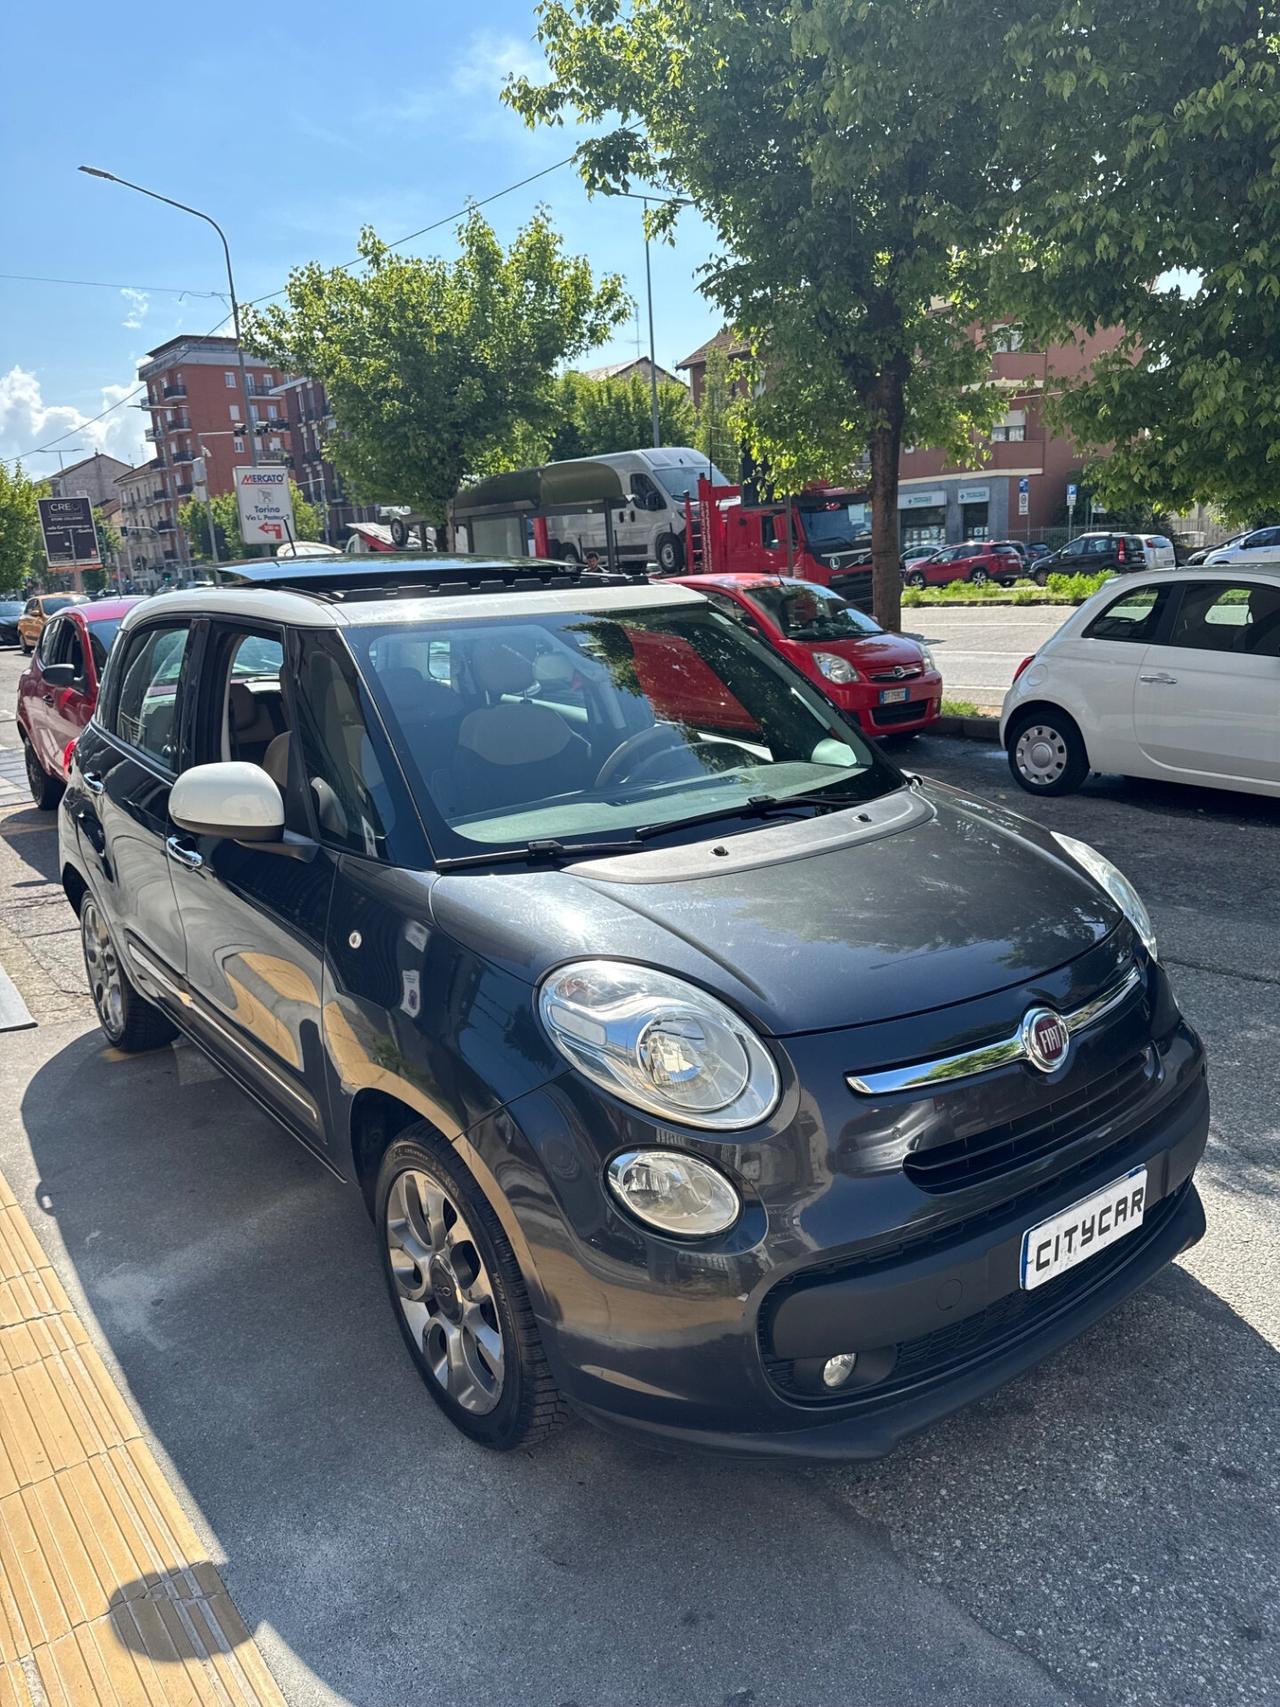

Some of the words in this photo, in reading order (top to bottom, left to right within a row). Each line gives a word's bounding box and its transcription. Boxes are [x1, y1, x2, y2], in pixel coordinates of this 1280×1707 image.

[254, 505, 280, 513] Torino
[1039, 1025, 1061, 1054] FIAT
[1036, 1187, 1144, 1272] CITYCAR
